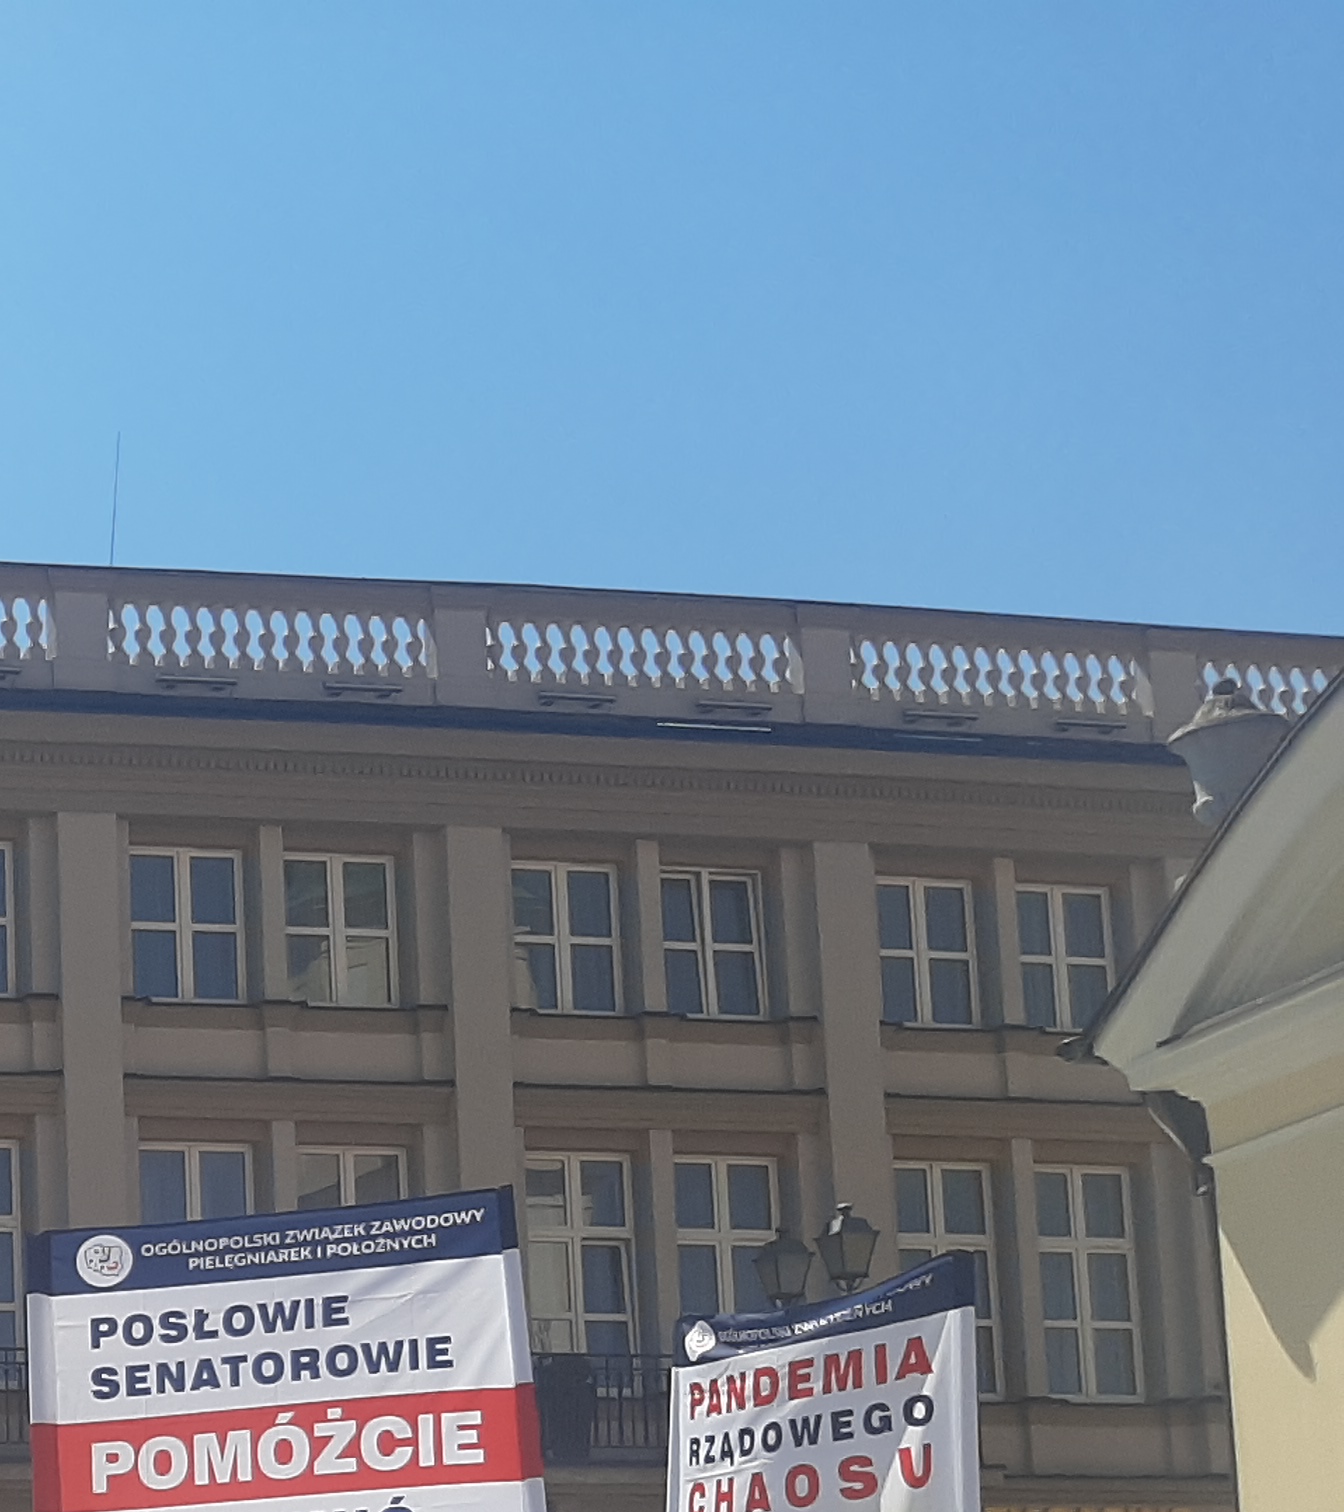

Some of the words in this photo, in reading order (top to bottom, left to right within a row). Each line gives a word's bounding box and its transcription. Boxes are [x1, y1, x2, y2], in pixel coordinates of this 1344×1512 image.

[141, 1233, 281, 1258] OGÓLNOPOLSKI
[285, 1221, 367, 1245] ZWIĄZEK
[370, 1208, 486, 1233] ZAWODOWY
[188, 1247, 313, 1271] PIELĘGNIAREK
[326, 1233, 437, 1259] POŁOŻNYCH
[90, 1295, 350, 1349] POSŁOWIE
[91, 1336, 454, 1400] SENATOROWIE
[689, 1335, 934, 1421] PANDEMIA
[91, 1408, 485, 1494] POMÓŻCIE
[689, 1394, 934, 1467] RZĄDOWEGO
